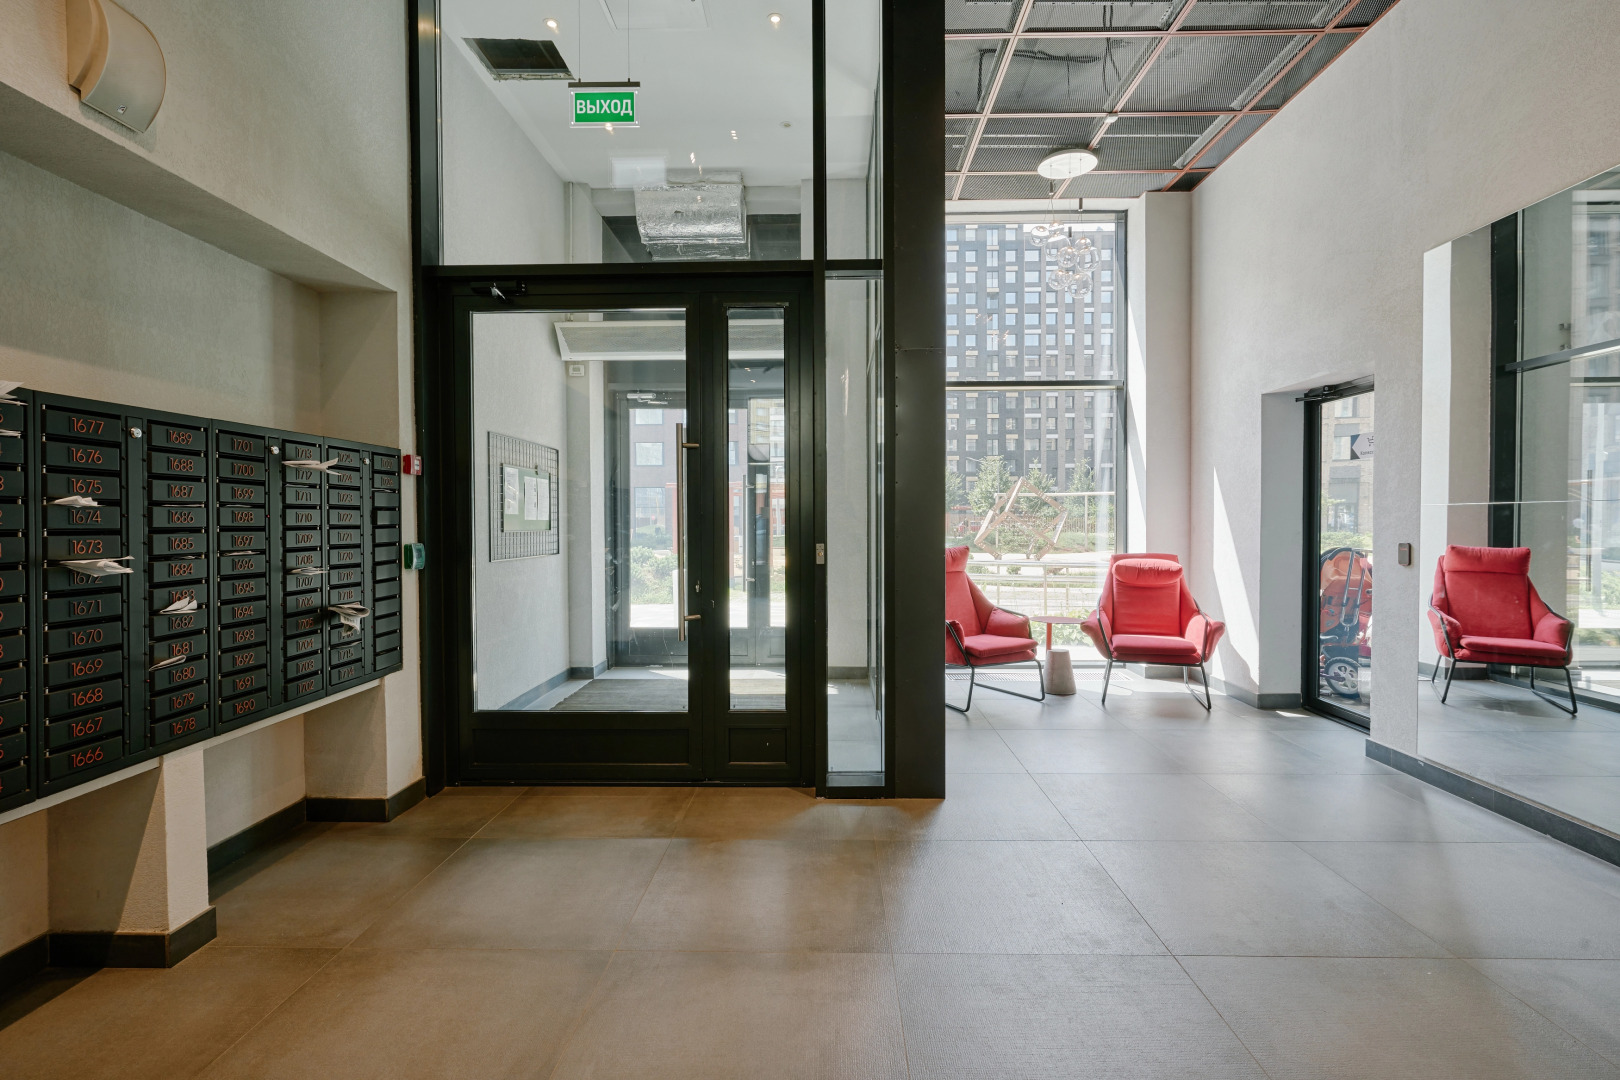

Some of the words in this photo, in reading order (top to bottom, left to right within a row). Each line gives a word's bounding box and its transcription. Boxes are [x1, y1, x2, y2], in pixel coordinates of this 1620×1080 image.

[576, 99, 633, 116] ВЫХОД
[72, 418, 104, 434] 1677
[170, 430, 192, 445] 1689
[233, 438, 254, 452] 1701
[71, 448, 103, 464] 1676
[170, 457, 194, 472] 1688
[233, 462, 254, 476] 1700
[71, 478, 102, 494] 1675
[171, 485, 194, 498] 1687
[234, 487, 254, 500] 1699
[72, 509, 102, 524] 1674
[171, 511, 194, 524] 1686
[234, 511, 254, 523] 1698
[72, 540, 103, 554] 1673
[171, 537, 194, 550] 1685
[234, 535, 254, 548] 1697
[171, 563, 193, 576] 1684
[234, 558, 254, 572] 1696
[172, 588, 195, 602] 1683
[234, 582, 255, 595] 1695
[73, 600, 102, 616] 1671
[234, 605, 254, 619] 1694
[171, 615, 194, 630] 1682
[72, 628, 103, 646] 1670
[235, 629, 255, 643] 1693
[172, 640, 194, 656] 1681
[235, 652, 255, 666] 1692
[72, 658, 103, 676] 1669
[172, 666, 195, 682] 1680
[235, 676, 255, 691] 1691
[72, 688, 103, 707] 1668
[172, 692, 195, 709] 1679
[235, 699, 255, 714] 1690
[72, 717, 103, 737] 1667
[172, 718, 196, 735] 1678
[71, 747, 104, 768] 1666
